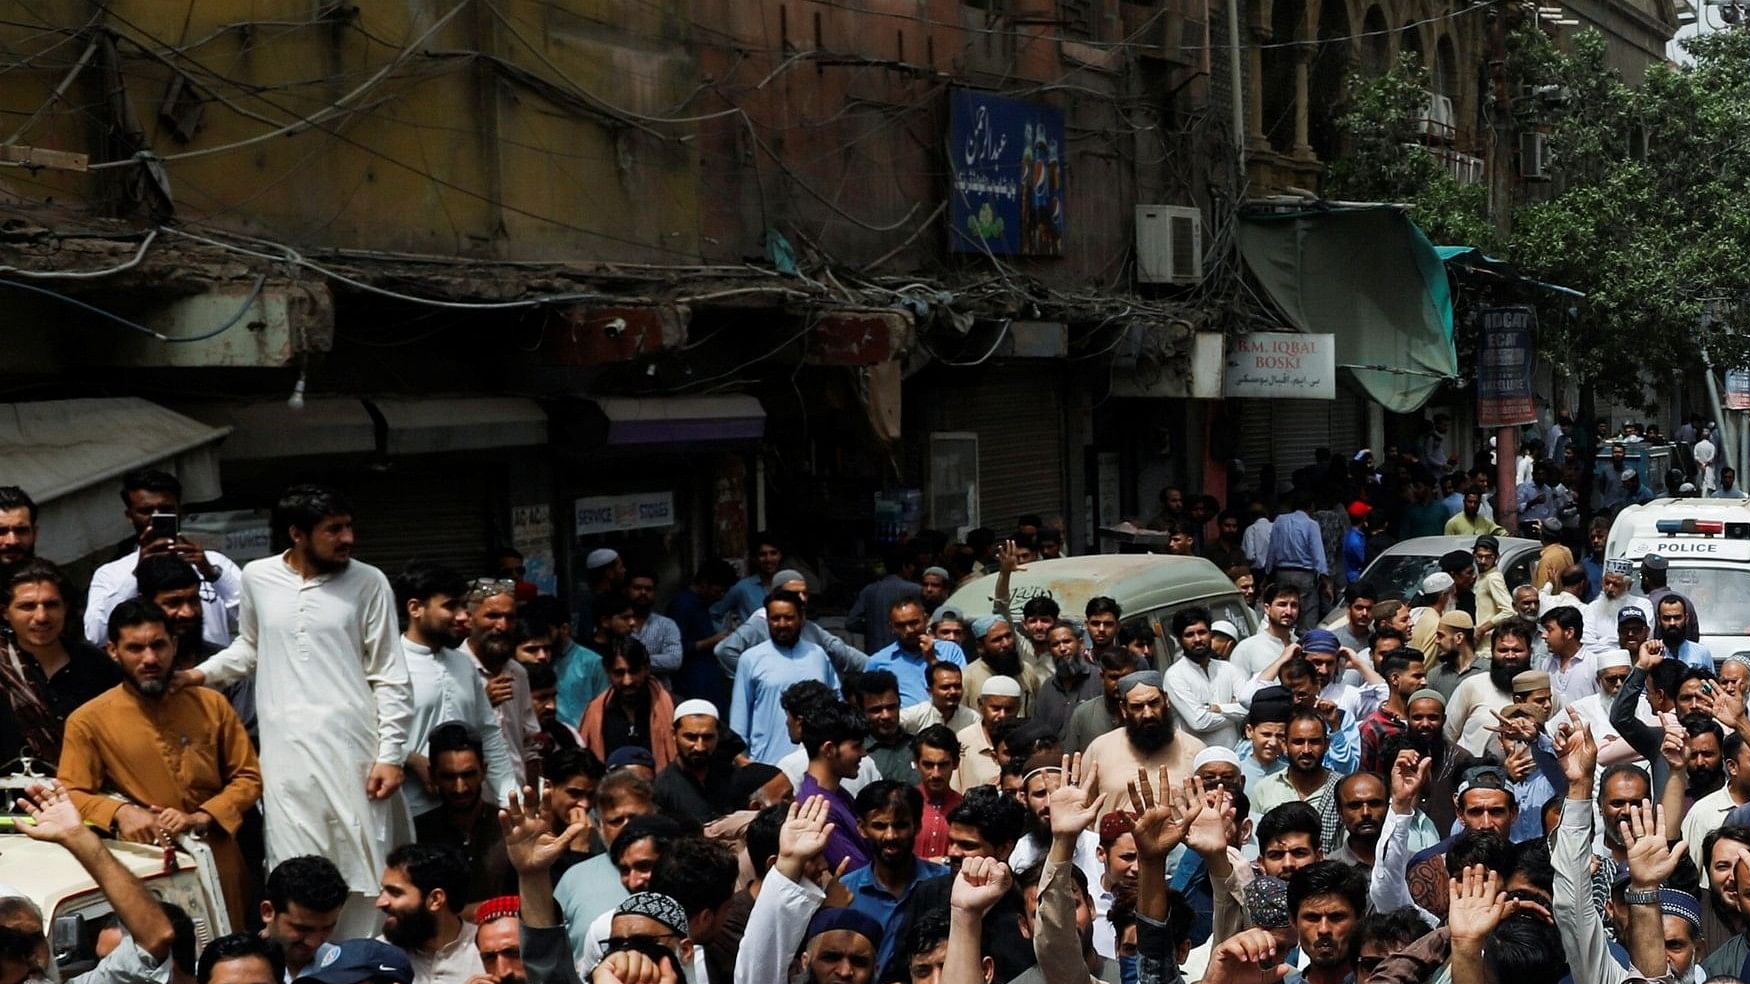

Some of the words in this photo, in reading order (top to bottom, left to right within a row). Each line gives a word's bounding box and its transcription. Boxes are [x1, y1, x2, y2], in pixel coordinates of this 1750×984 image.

[1272, 341, 1317, 356] IQBAL
[1255, 356, 1301, 369] BOSKI
[578, 508, 612, 525] SERVICE
[1657, 543, 1718, 552] POLICE
